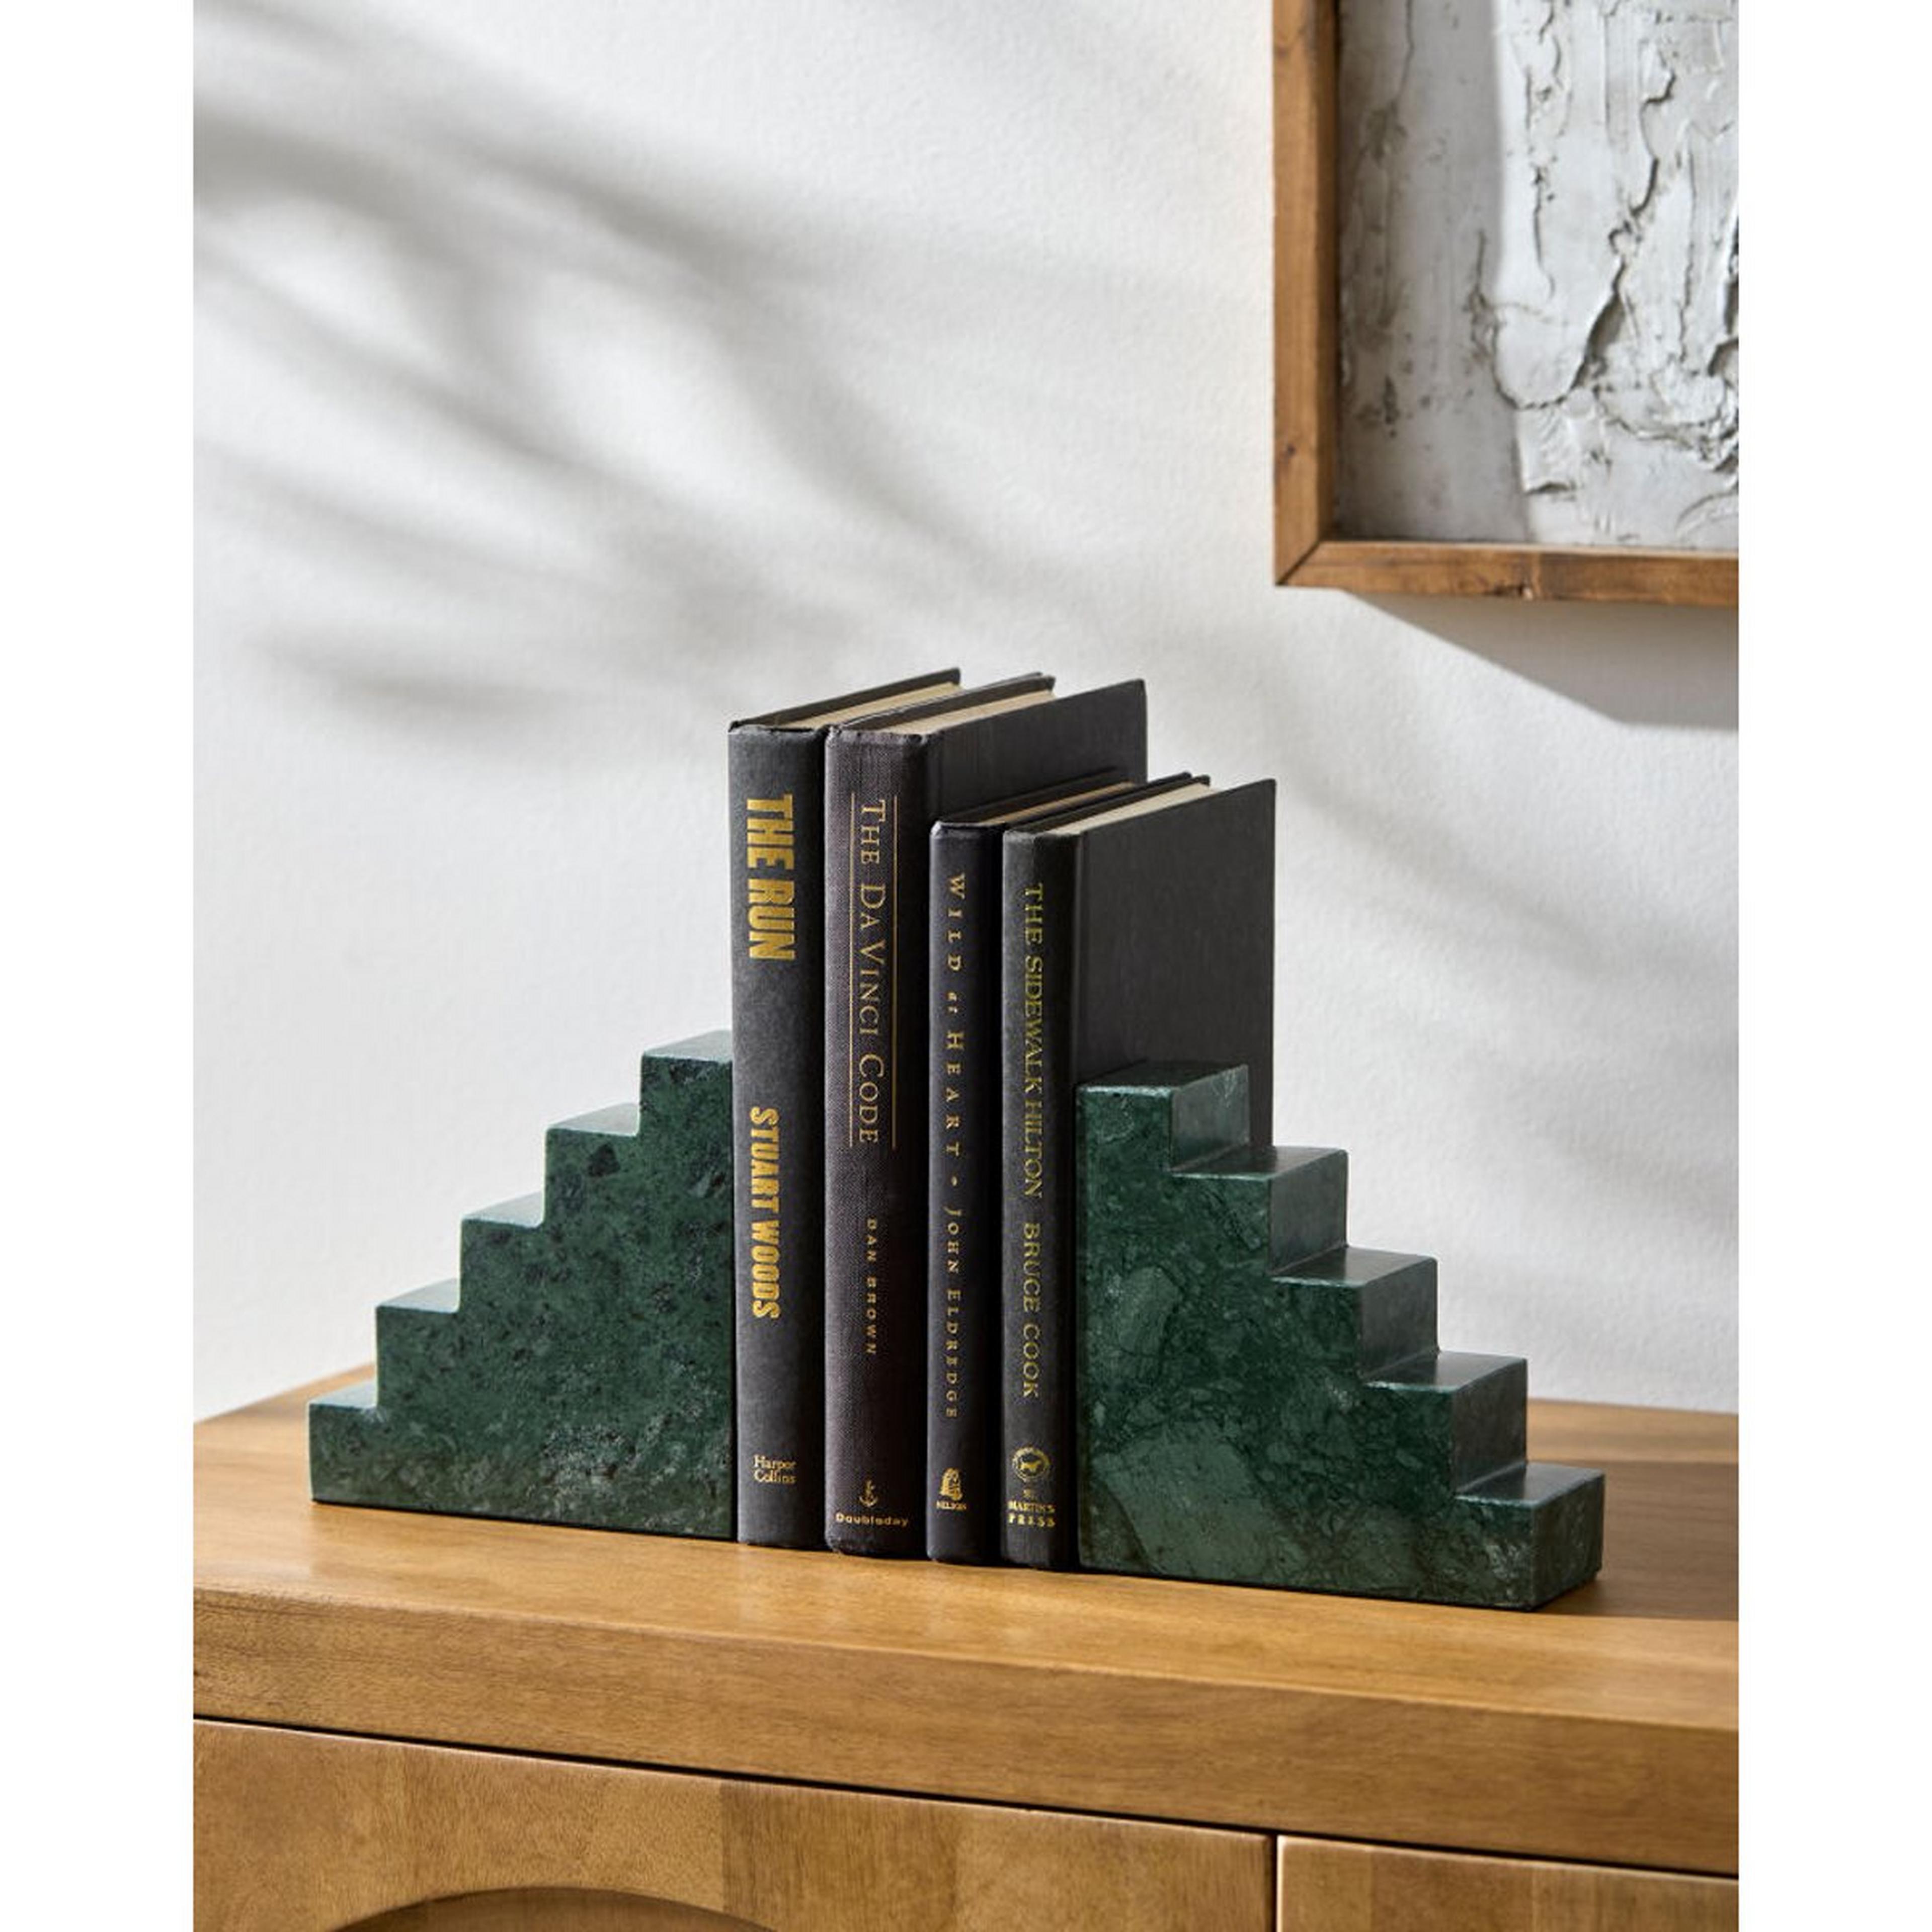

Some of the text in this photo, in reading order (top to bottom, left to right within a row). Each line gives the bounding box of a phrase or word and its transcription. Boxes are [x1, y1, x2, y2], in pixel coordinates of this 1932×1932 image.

[747, 793, 795, 960] THE RUN
[947, 873, 965, 971] WILD
[859, 799, 886, 1143] THE DA VINCI CODE
[1024, 882, 1043, 1198] THE SIDEWALK HILTON
[945, 1031, 964, 1156] HEART
[750, 1106, 781, 1319] STUART WOODS
[866, 1218, 877, 1354] DAN BROWN
[942, 1206, 961, 1417] JOHN ELDREDGE
[1023, 1223, 1041, 1397] BRUCE COOK
[754, 1454, 796, 1470] Harper
[754, 1469, 797, 1484] Collins
[835, 1511, 909, 1527] Doubleday
